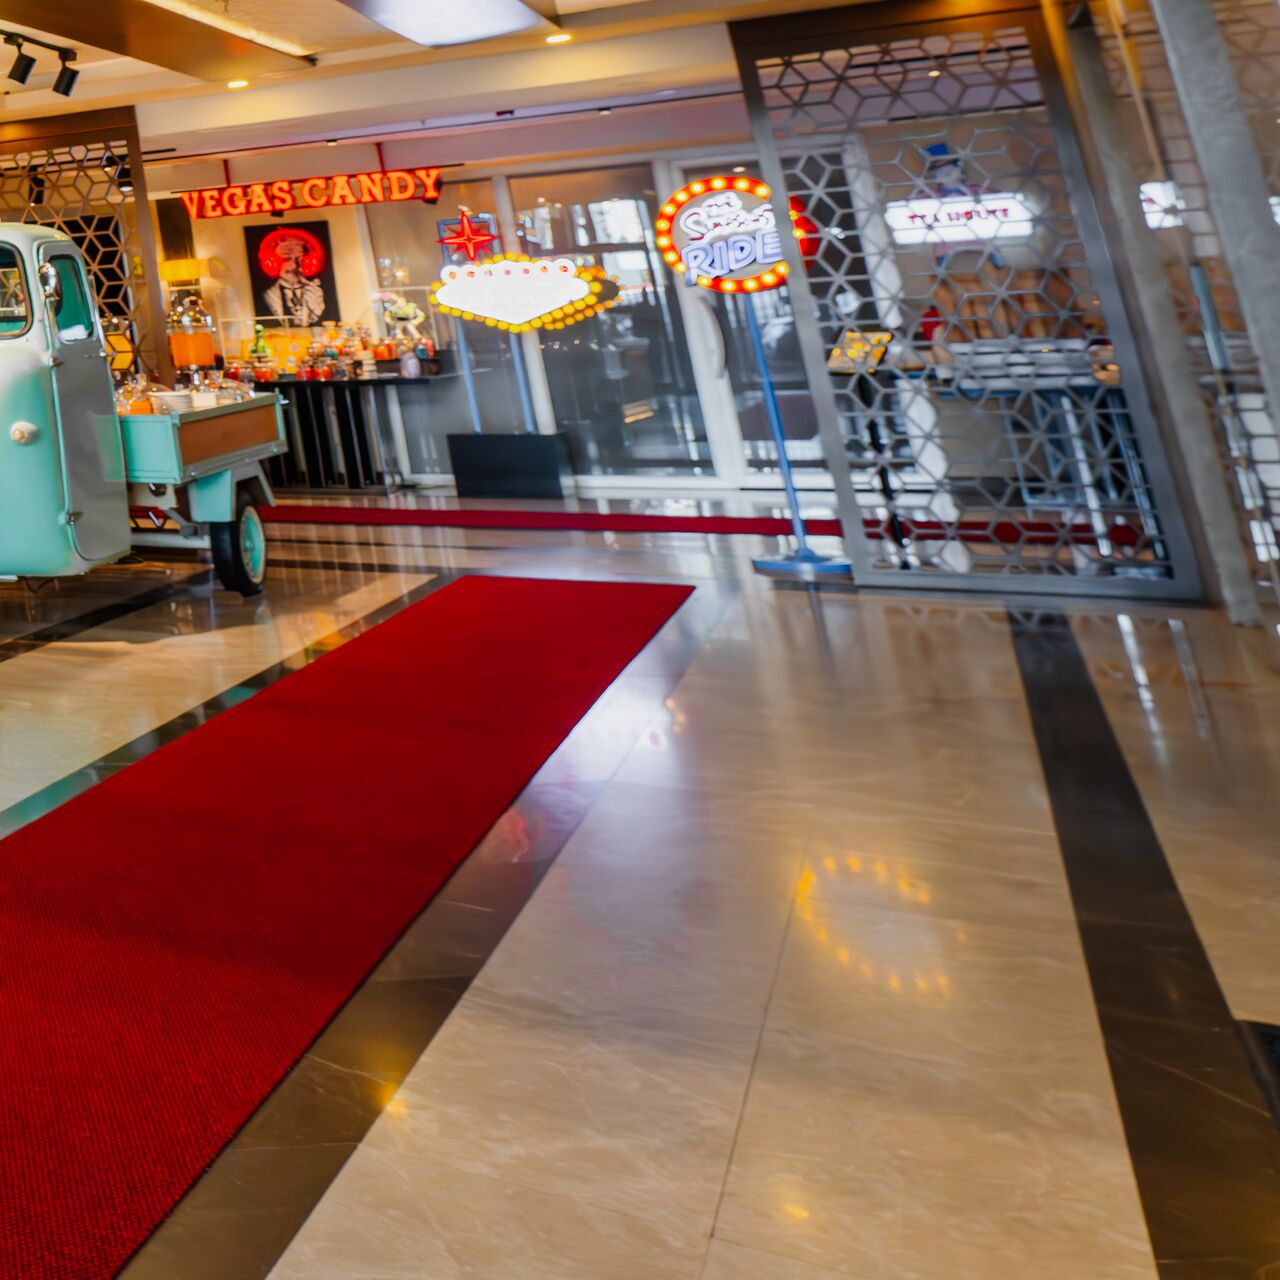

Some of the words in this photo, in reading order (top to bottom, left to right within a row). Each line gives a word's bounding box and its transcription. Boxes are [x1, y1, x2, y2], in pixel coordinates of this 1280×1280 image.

[180, 180, 295, 219] VEGAS
[300, 168, 442, 208] CANDY
[681, 228, 784, 286] RIDE
